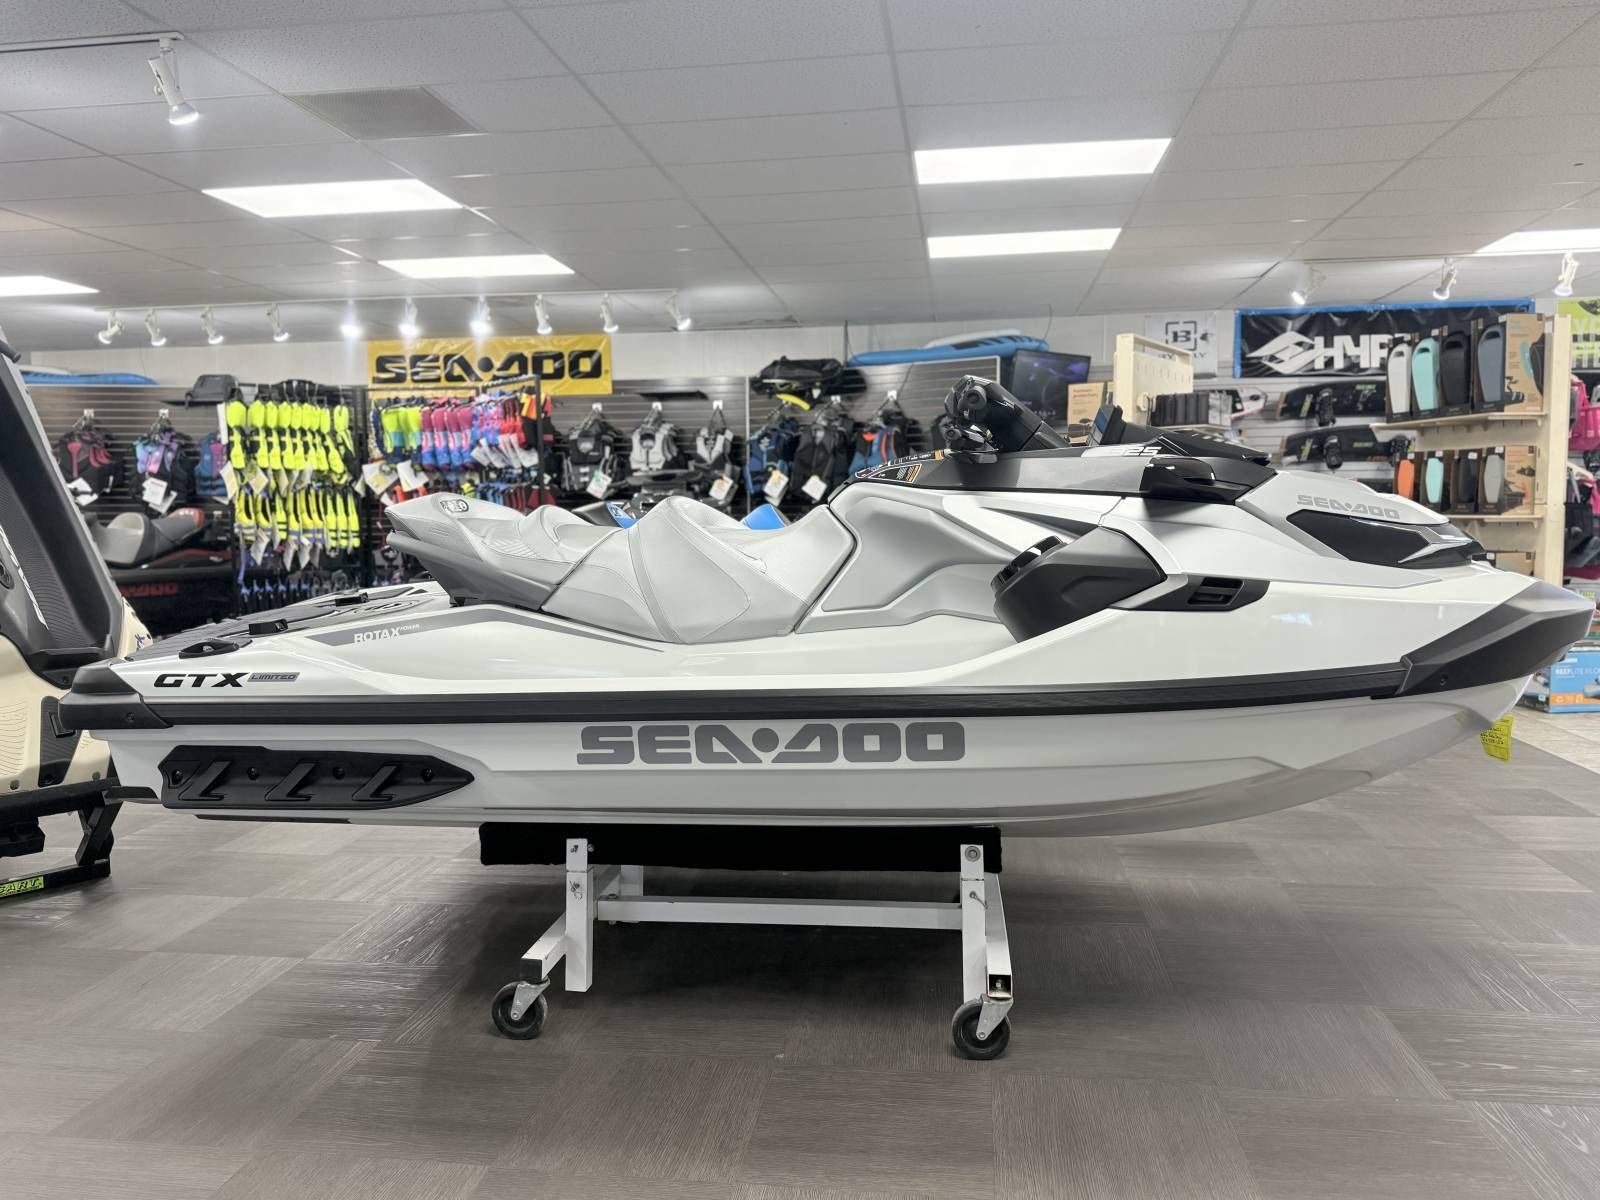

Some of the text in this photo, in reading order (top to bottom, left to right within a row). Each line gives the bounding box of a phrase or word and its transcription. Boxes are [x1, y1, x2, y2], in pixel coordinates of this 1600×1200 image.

[353, 627, 401, 644] ROTAX
[153, 672, 298, 688] GTX LIMITED
